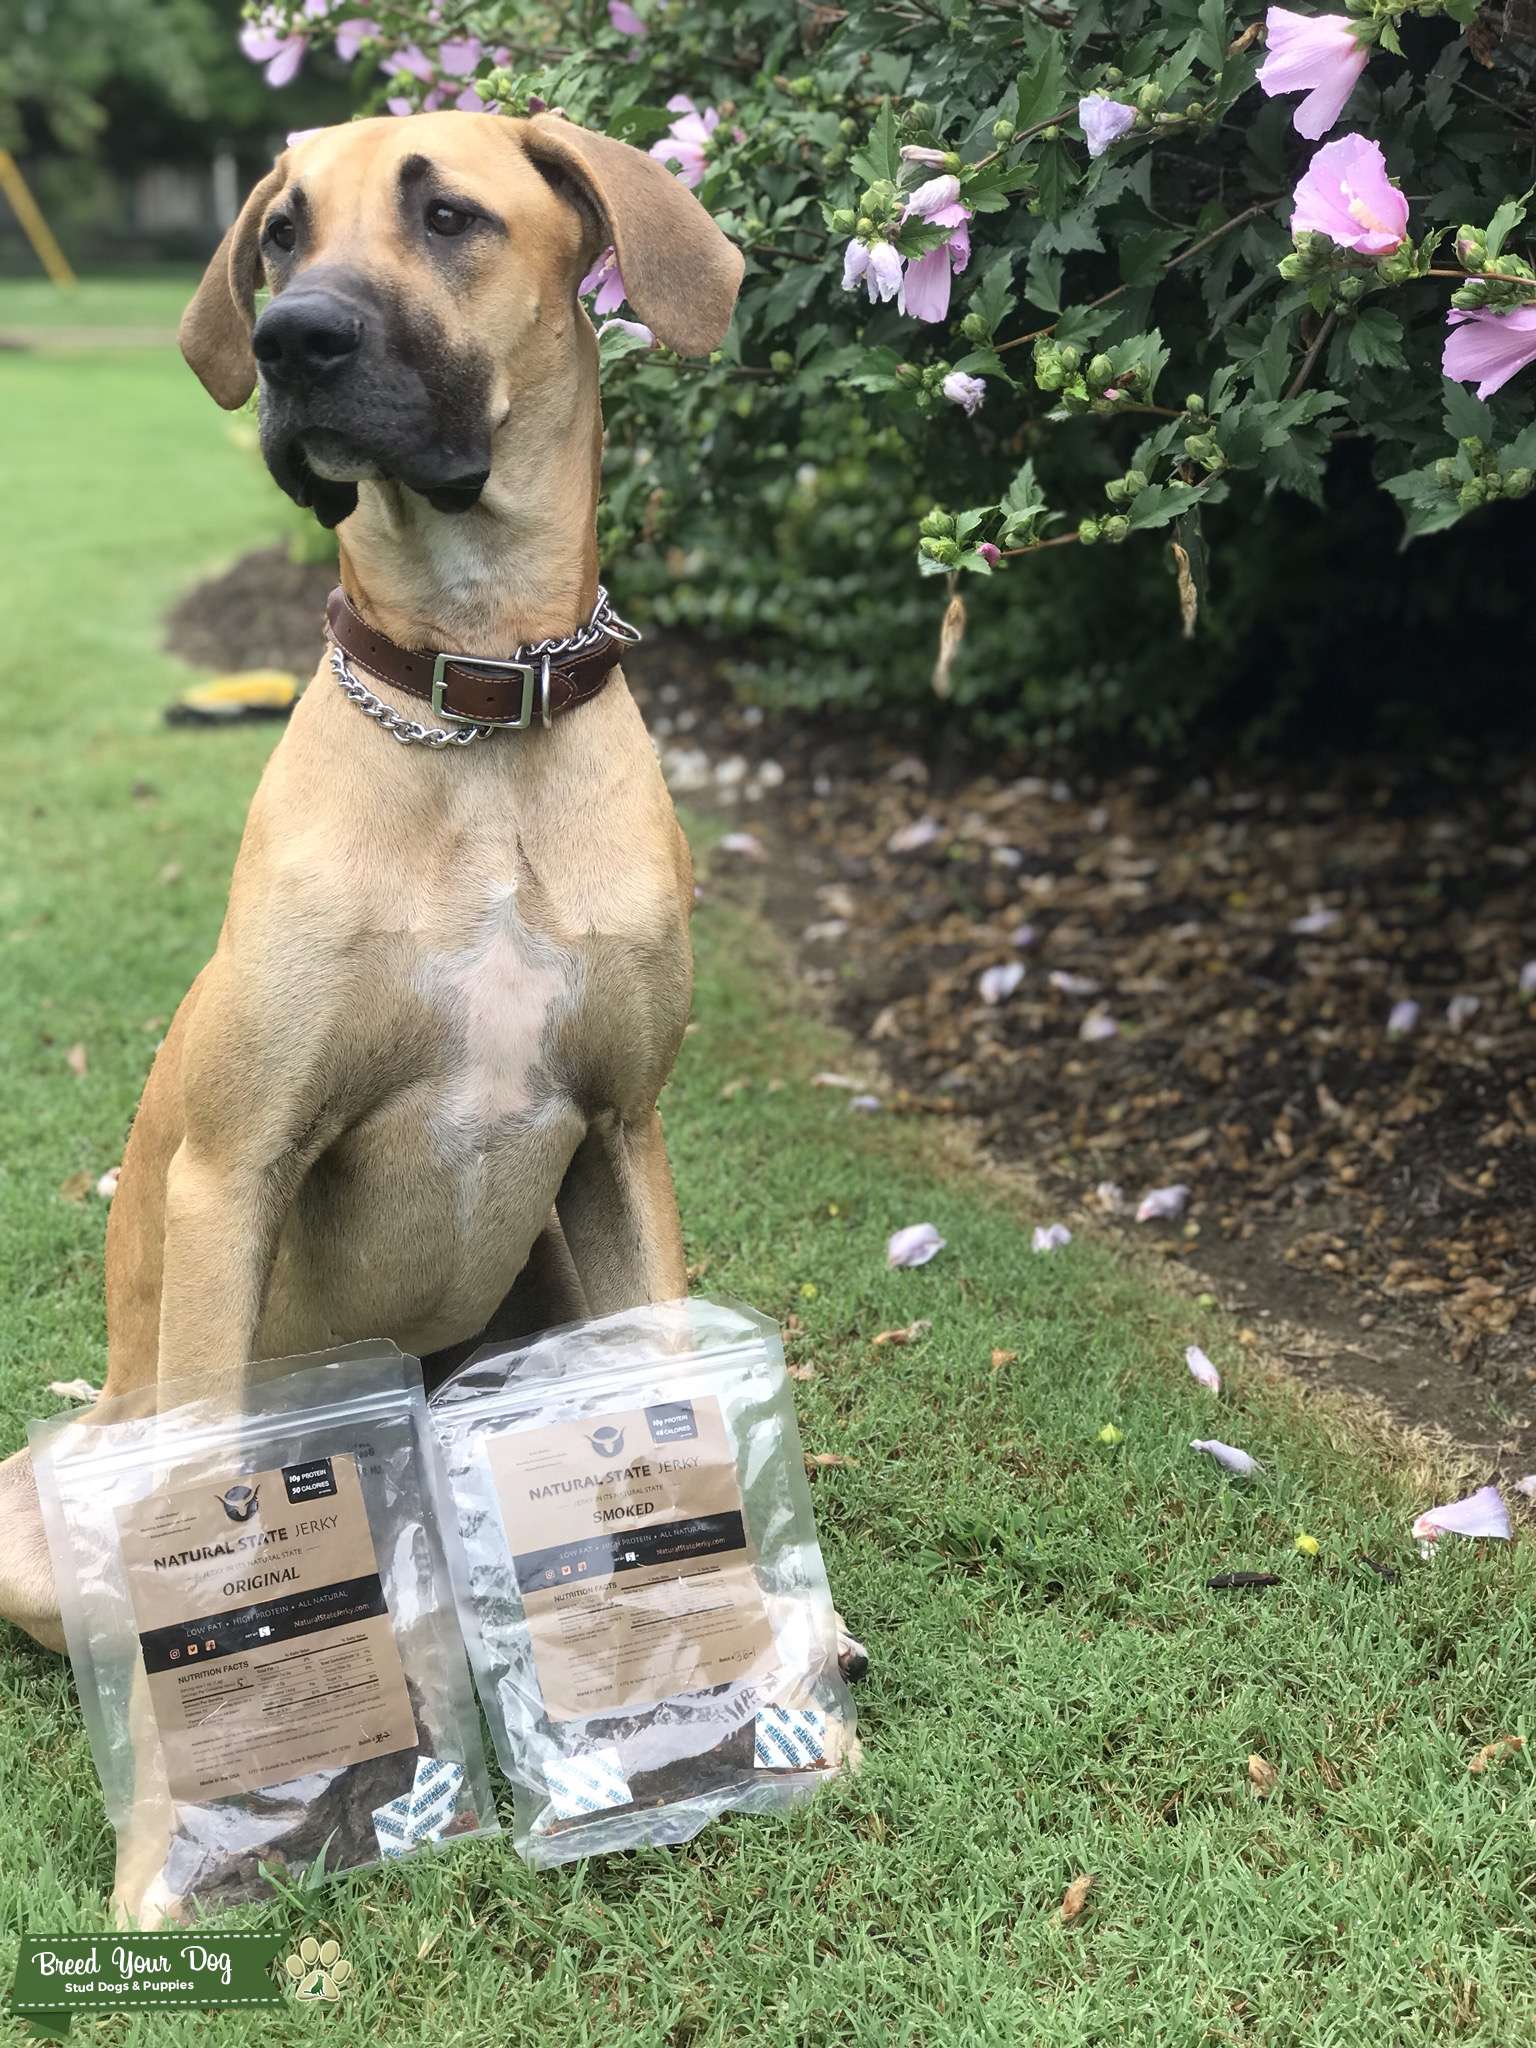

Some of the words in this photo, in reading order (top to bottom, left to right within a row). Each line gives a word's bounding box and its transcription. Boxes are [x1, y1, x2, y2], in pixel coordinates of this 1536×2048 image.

[663, 1414, 688, 1424] PROTEIN
[663, 1424, 691, 1435] CALORIES
[300, 1468, 326, 1480] PROTEIN
[528, 1474, 603, 1500] NATURAL
[605, 1464, 651, 1483] STATE
[656, 1455, 699, 1474] JERKY
[291, 1486, 301, 1494] 50
[300, 1479, 330, 1492] CALORIES
[591, 1500, 655, 1524] SMOKED
[153, 1540, 234, 1571] NATURAL
[237, 1527, 288, 1551] STATE
[293, 1514, 339, 1537] JERKY
[621, 1533, 652, 1546] PROTEIN
[659, 1530, 672, 1539] ALL
[673, 1523, 706, 1536] NATURAL
[280, 1547, 302, 1558] STATE
[221, 1565, 301, 1596] ORIGINAL
[185, 1625, 206, 1637] LOW
[207, 1621, 222, 1632] FAT
[232, 1613, 253, 1625] HIGH
[255, 1605, 289, 1619] PROTEIN
[297, 1598, 312, 1608] ALL
[312, 1589, 348, 1604] NATURAL
[293, 1602, 370, 1628] NaturalStateJerky.com
[177, 1666, 223, 1684] NUTRITION
[222, 1660, 249, 1673] FACTS
[767, 1724, 800, 1762] STAYFRESH
[411, 1778, 449, 1814] STAYFRESH
